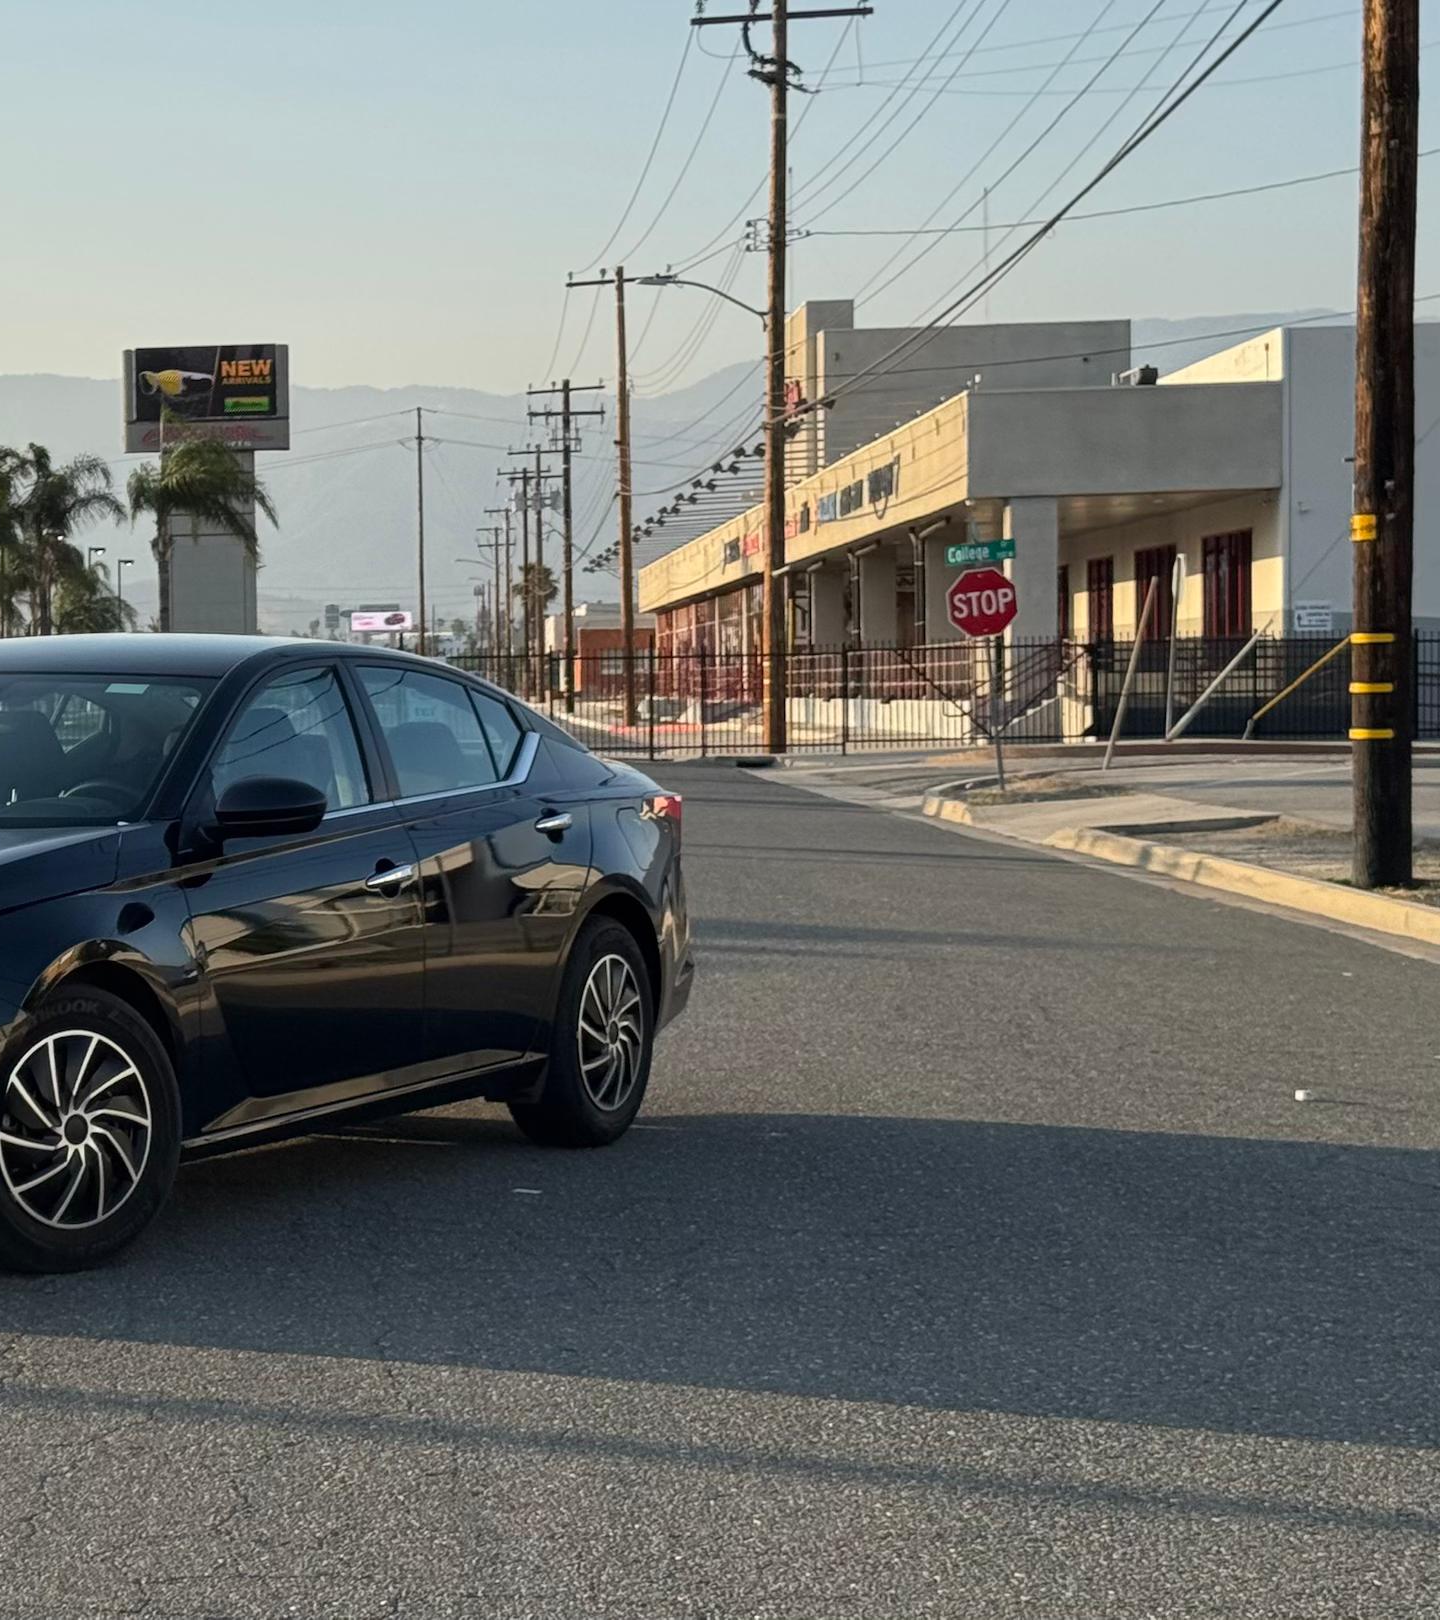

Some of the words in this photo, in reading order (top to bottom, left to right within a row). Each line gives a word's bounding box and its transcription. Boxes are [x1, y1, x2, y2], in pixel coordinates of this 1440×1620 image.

[221, 359, 272, 377] NEW
[221, 376, 272, 385] ARRIVALS
[947, 546, 990, 563] College
[953, 588, 1014, 618] STOP
